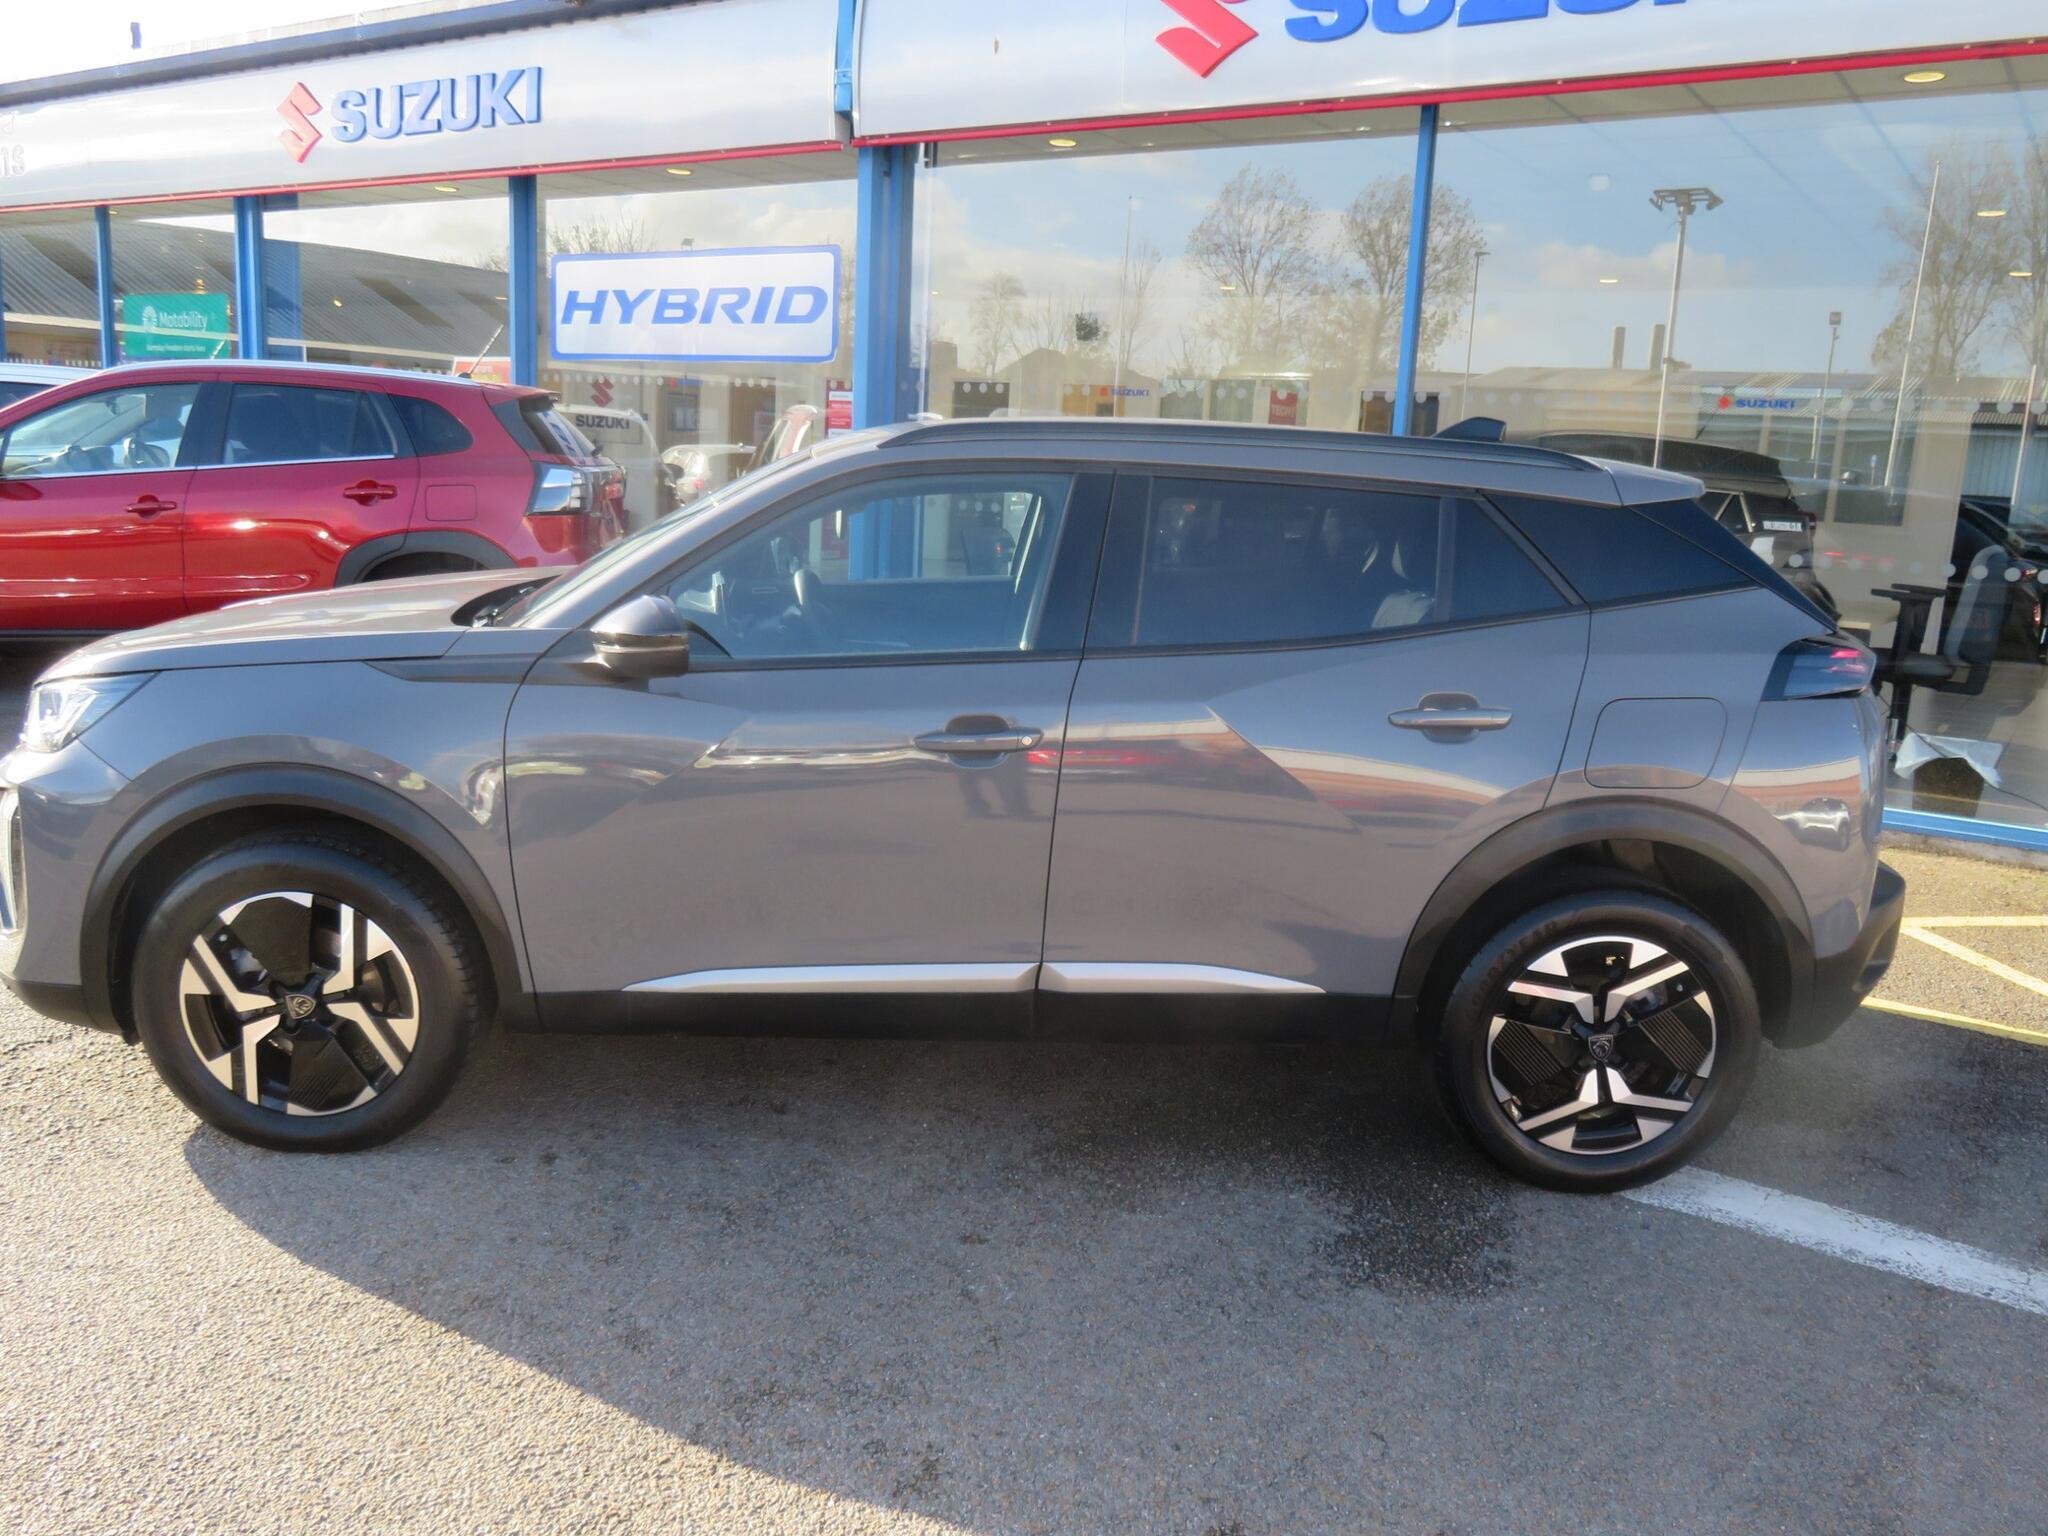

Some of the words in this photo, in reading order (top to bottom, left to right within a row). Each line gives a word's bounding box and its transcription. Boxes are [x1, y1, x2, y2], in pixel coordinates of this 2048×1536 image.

[331, 66, 542, 143] SUZUKI
[561, 286, 829, 325] HYBRID
[159, 311, 208, 331] Motability
[1736, 398, 1796, 409] SUZUKI
[575, 414, 630, 429] SUZUKI
